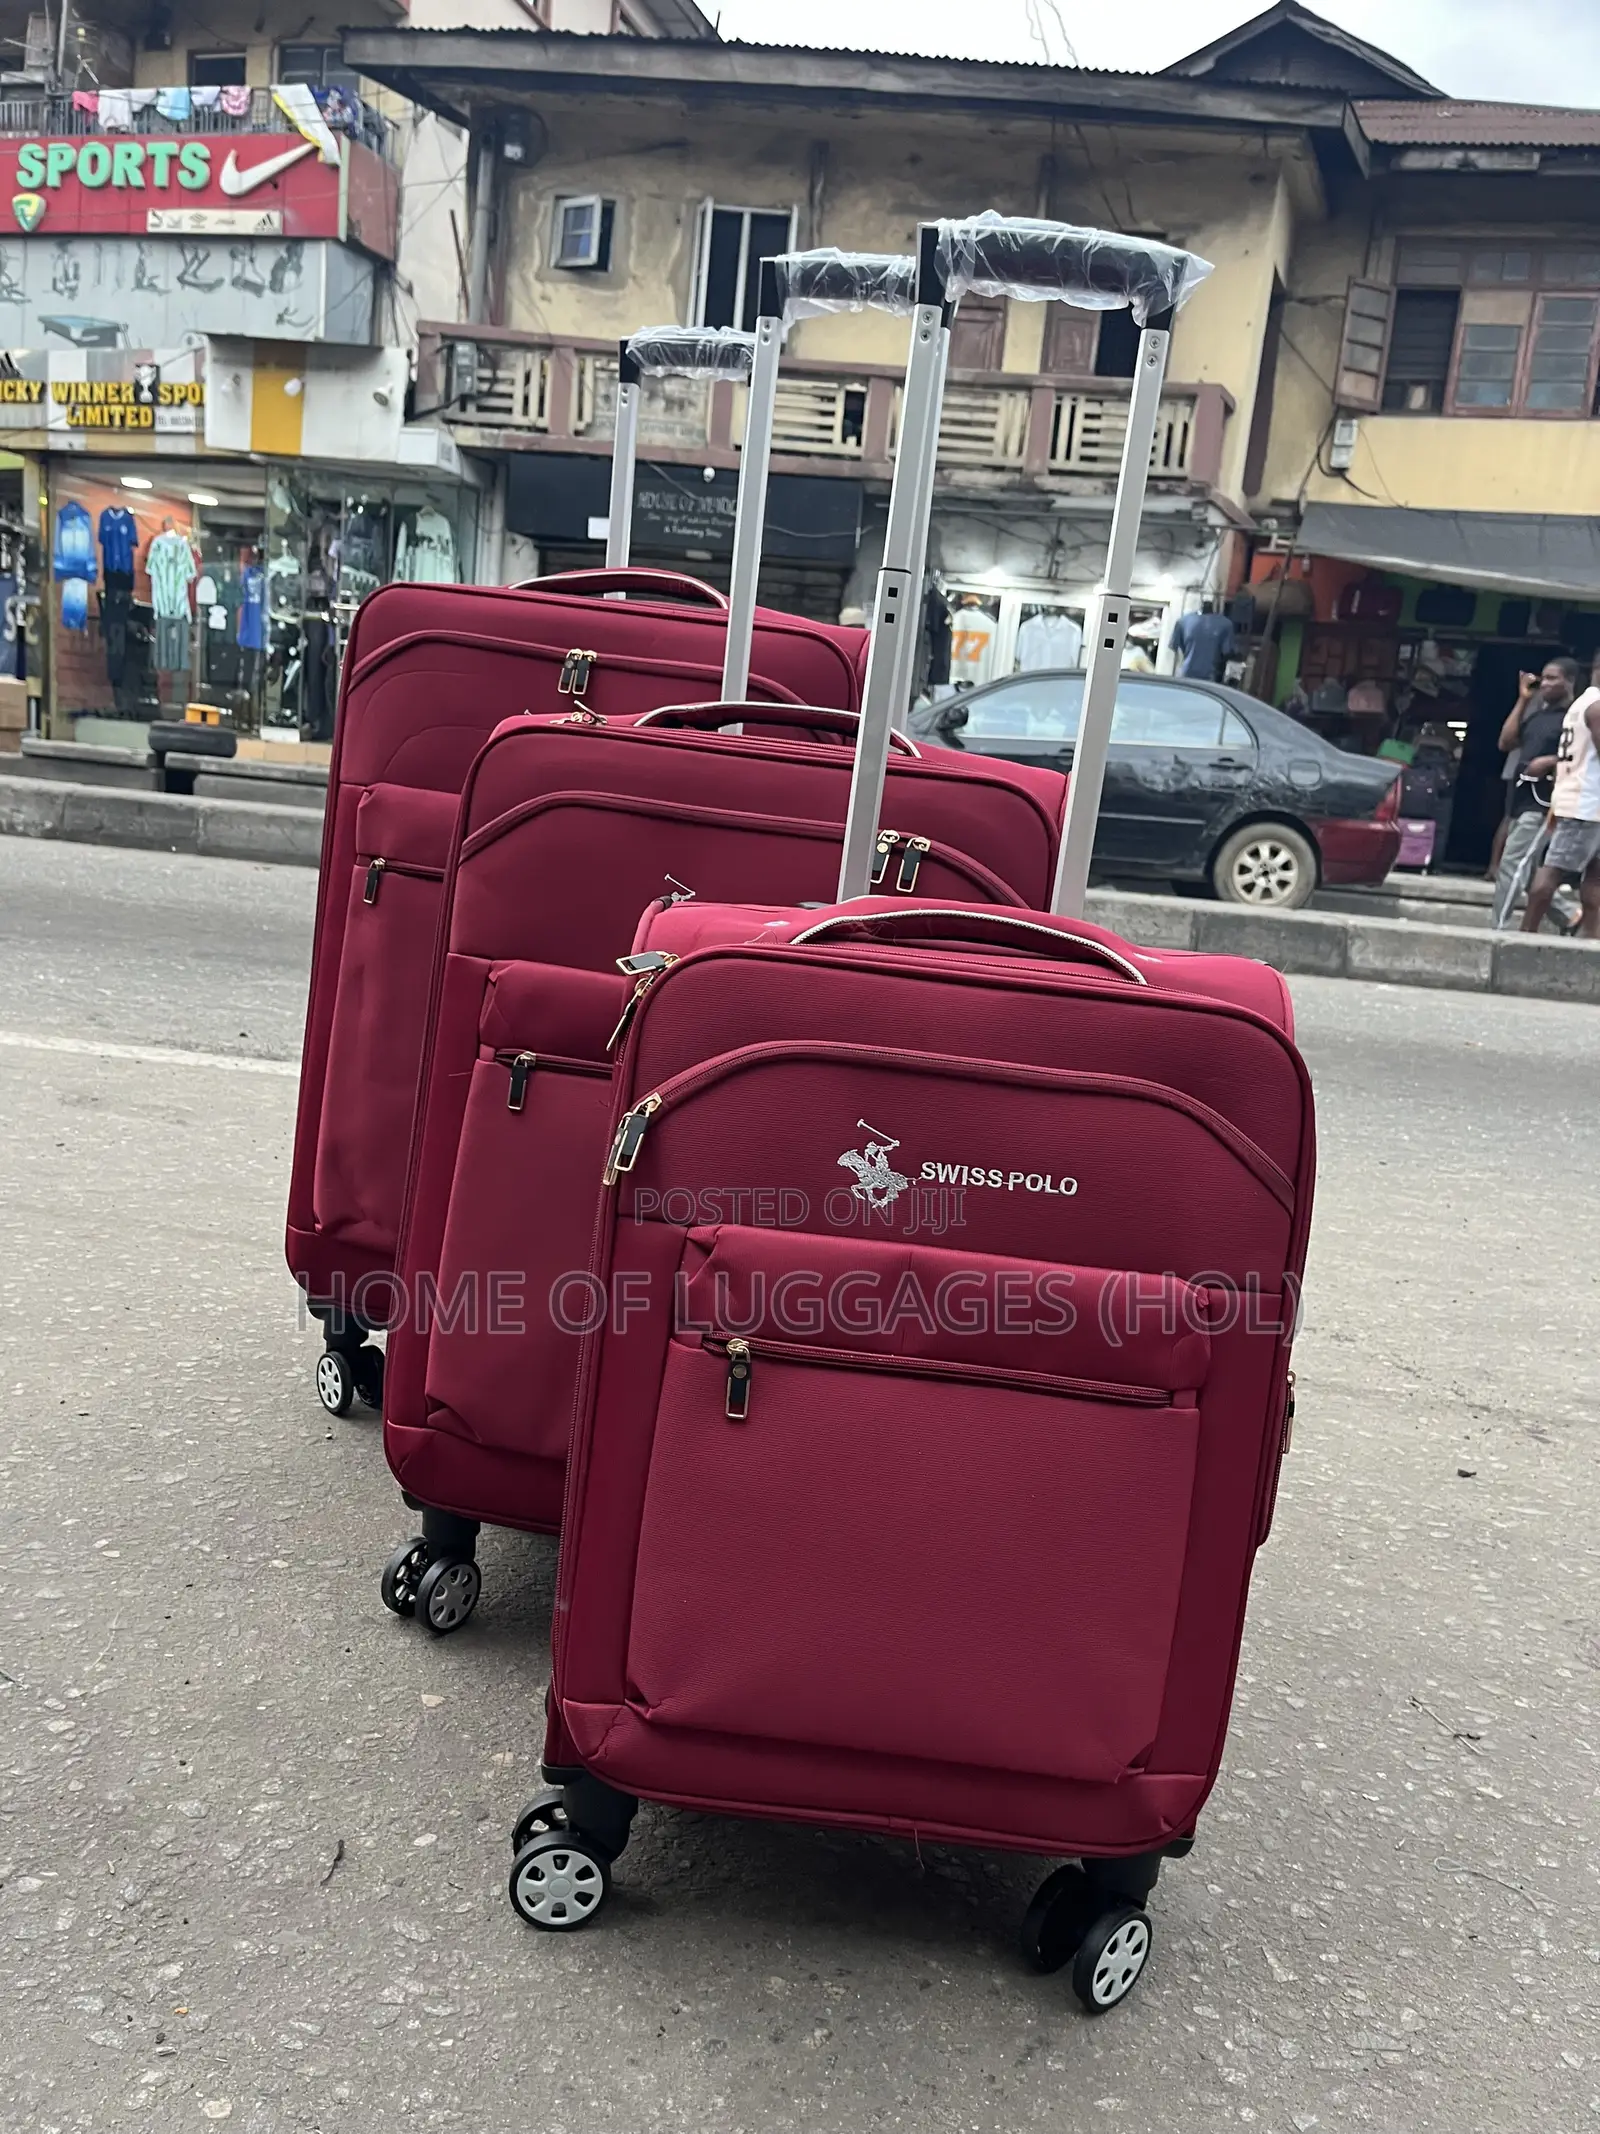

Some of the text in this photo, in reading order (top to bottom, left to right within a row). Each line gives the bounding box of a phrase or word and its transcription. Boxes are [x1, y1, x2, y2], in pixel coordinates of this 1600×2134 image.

[16, 141, 211, 190] SPORTS
[0, 379, 205, 406] CKY WINNER SPO
[921, 1161, 1078, 1196] SWISS POLO
